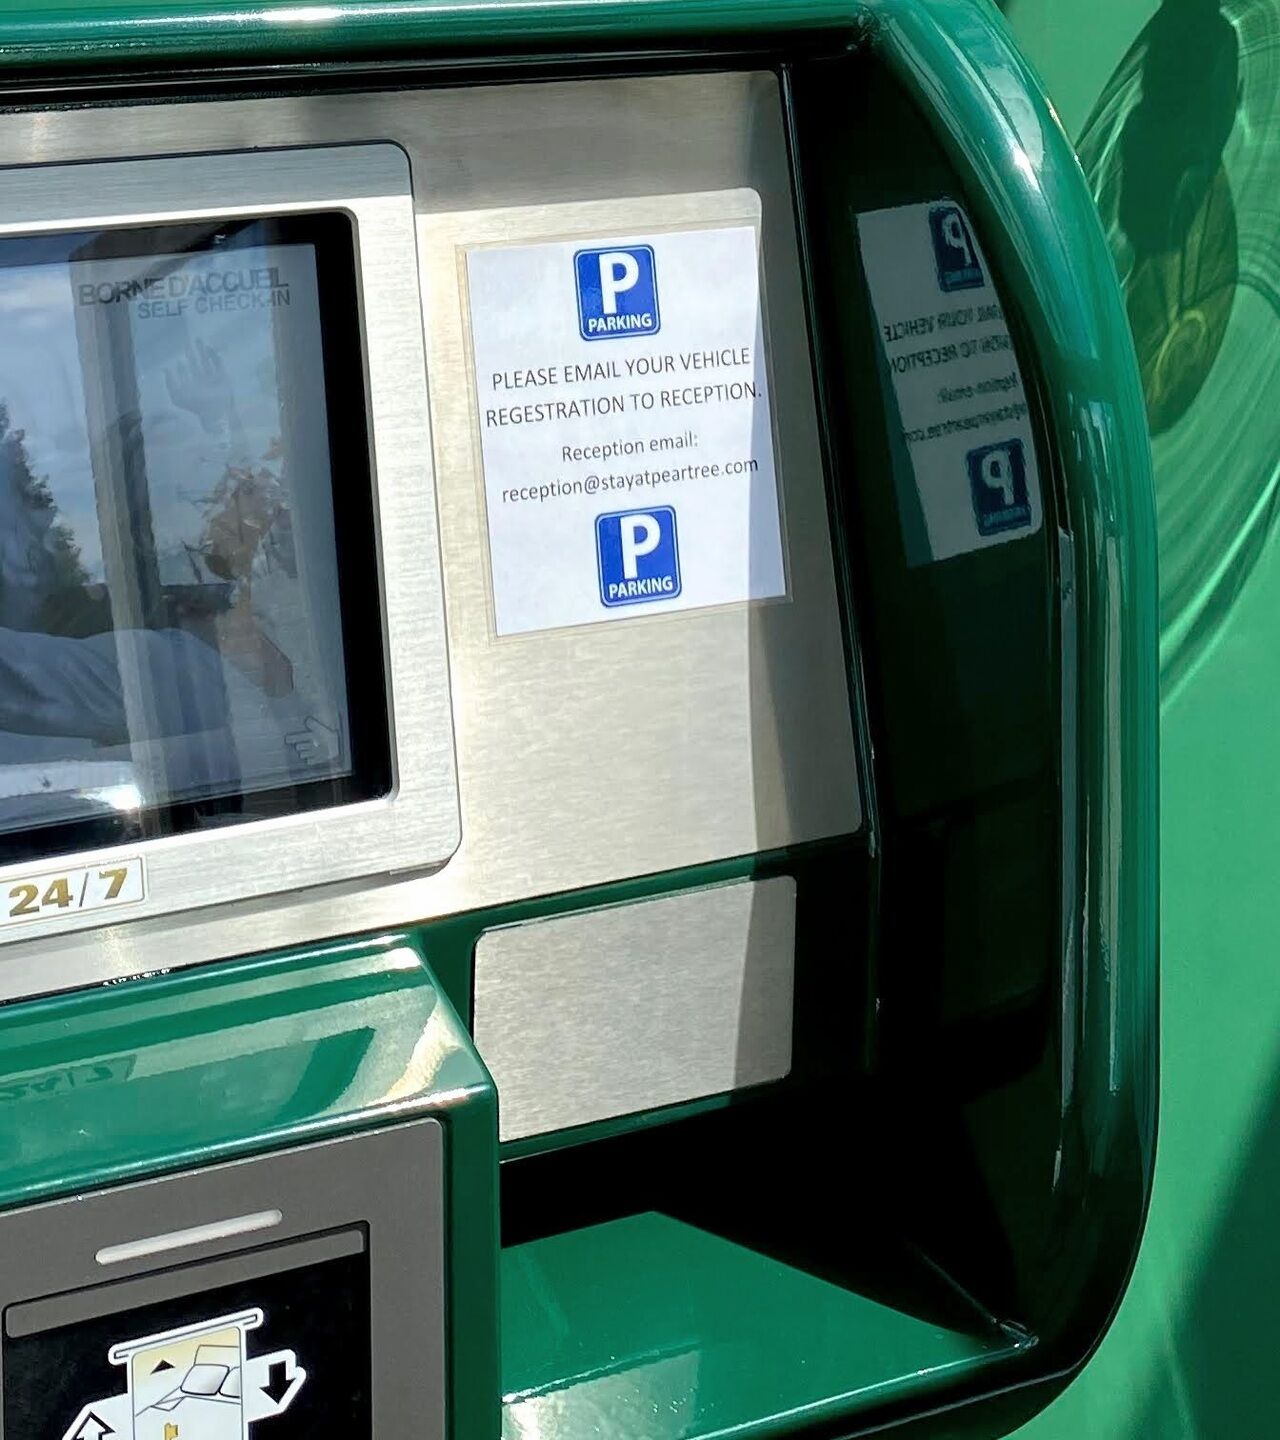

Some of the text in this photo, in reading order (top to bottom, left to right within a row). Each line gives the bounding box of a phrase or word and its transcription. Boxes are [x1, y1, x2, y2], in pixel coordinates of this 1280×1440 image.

[78, 266, 289, 307] BORNE D'ACCUEIL
[138, 288, 290, 320] SELF CHECK-IN
[599, 251, 638, 314] P
[587, 313, 653, 333] PARKING
[492, 347, 750, 391] PLEASE EMAIL YOUR VEHICLE
[486, 382, 762, 427] REGESTRATION TO RECEPTION.
[562, 431, 699, 464] Reception email:
[502, 458, 759, 503] reception@stayatpeartree.com
[619, 514, 661, 579] P
[608, 575, 674, 599] PARKING
[8, 868, 129, 917] 24/7
